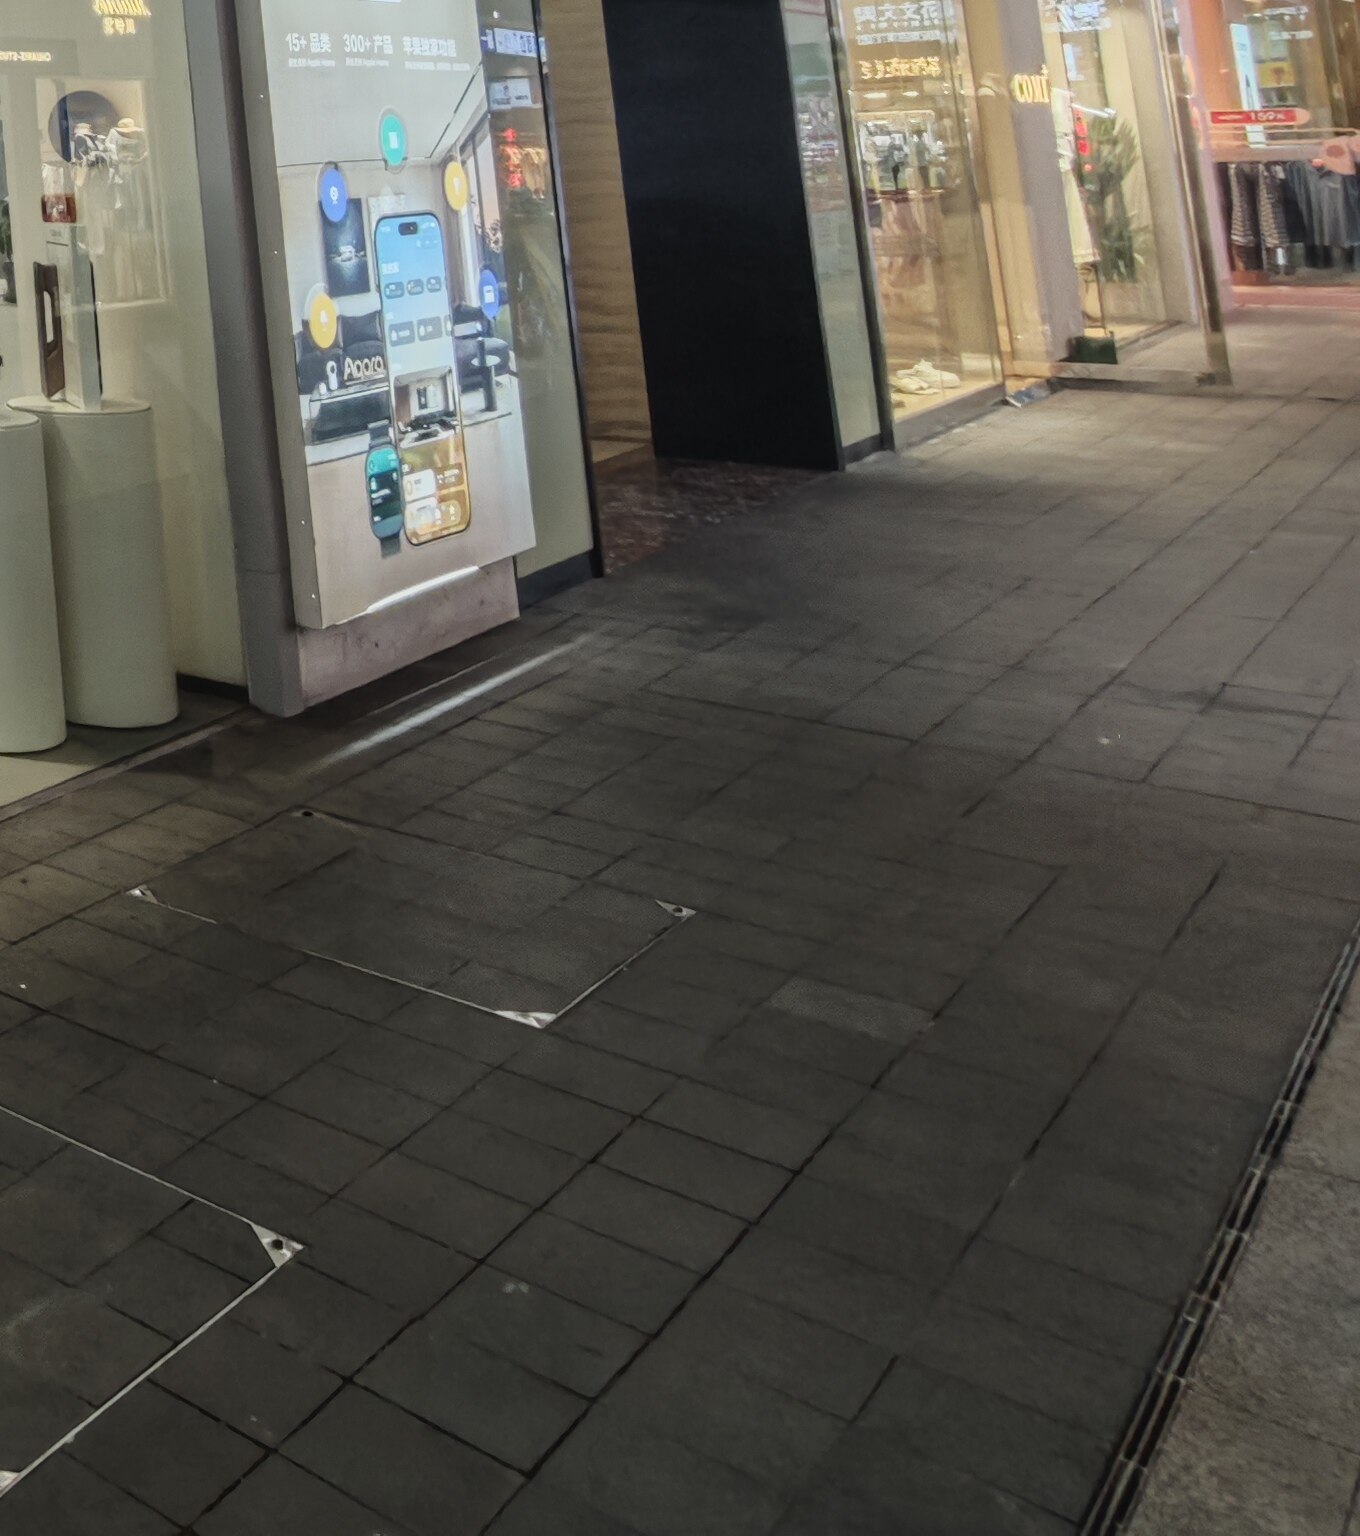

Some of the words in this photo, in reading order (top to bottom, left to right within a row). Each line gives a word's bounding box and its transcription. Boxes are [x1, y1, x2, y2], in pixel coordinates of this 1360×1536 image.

[286, 33, 307, 53] 15+
[309, 33, 332, 54] 品类
[343, 34, 371, 54] 300+
[373, 34, 394, 55] 产品
[344, 355, 385, 381] Aqara
